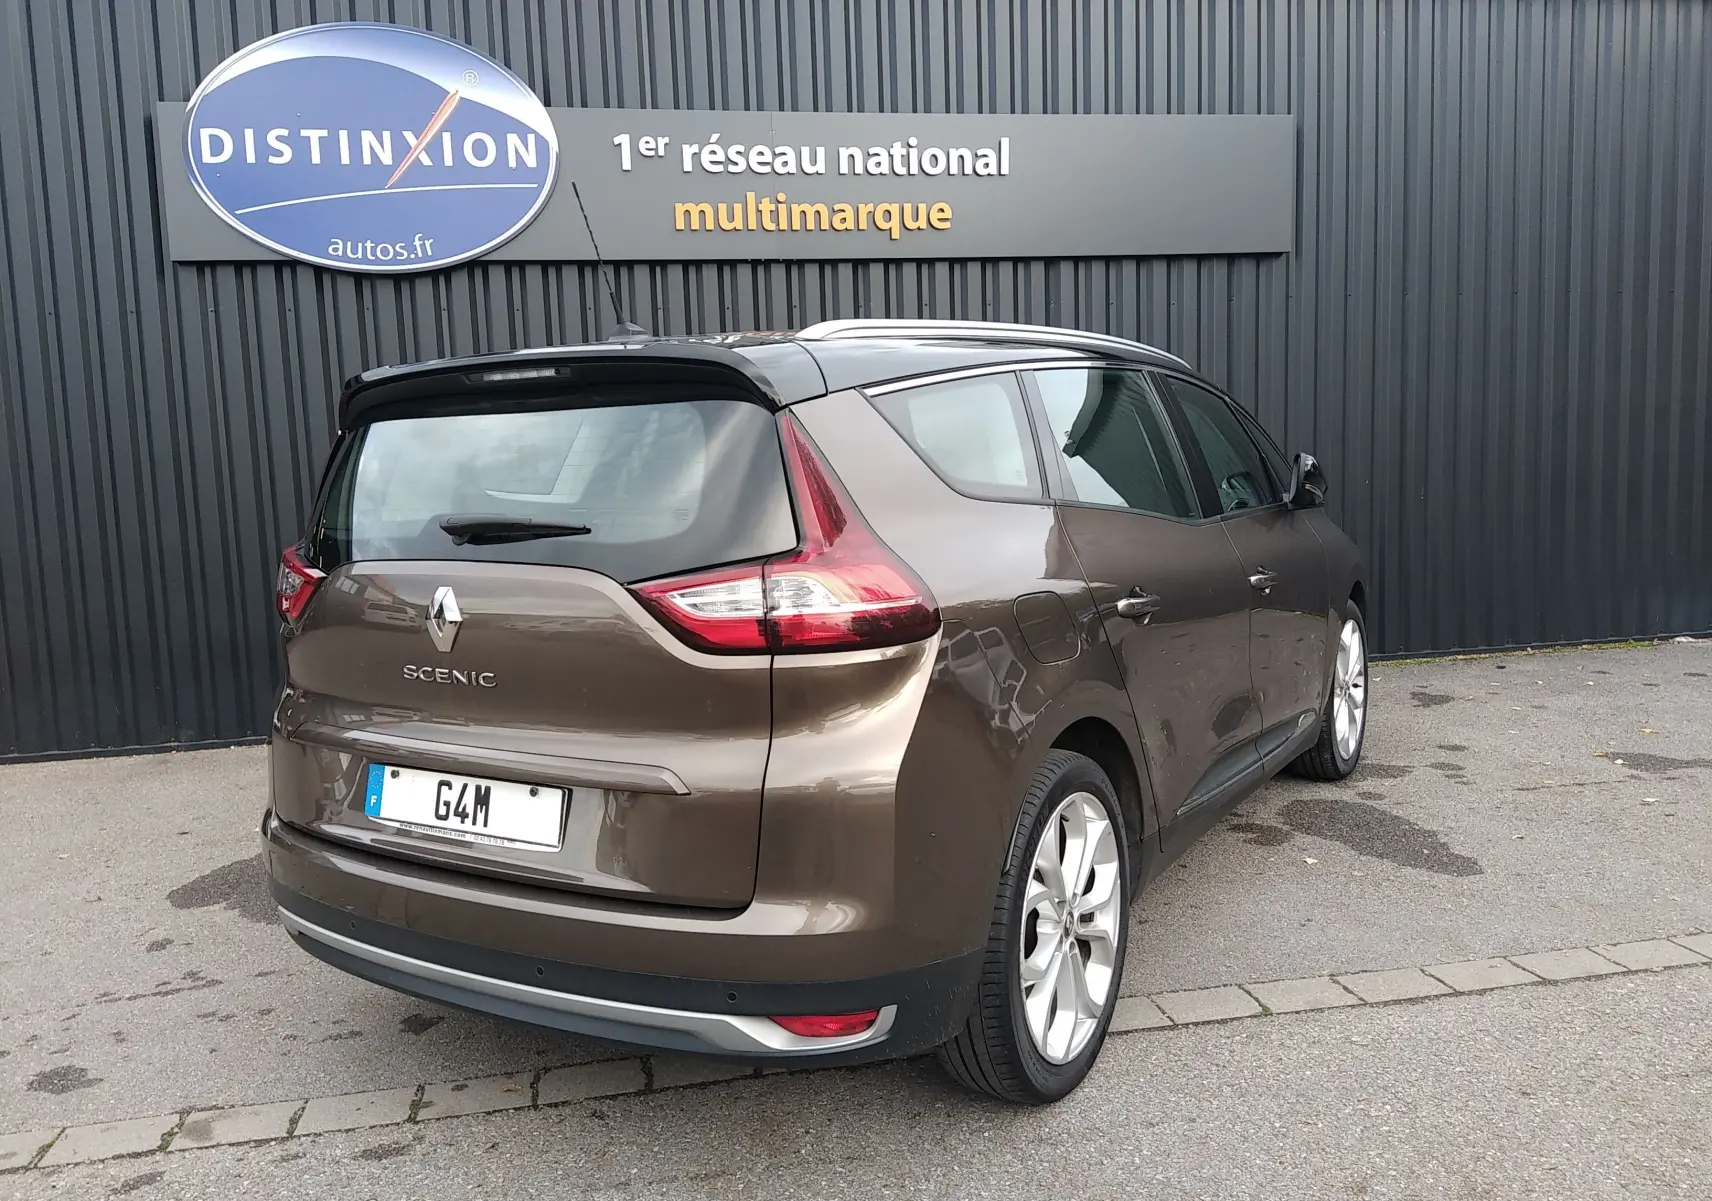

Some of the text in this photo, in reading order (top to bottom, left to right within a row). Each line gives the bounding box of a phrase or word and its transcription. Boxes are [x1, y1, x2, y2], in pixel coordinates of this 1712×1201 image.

[200, 127, 538, 169] DISTINXION
[612, 132, 1011, 176] 1er réseau national
[674, 191, 953, 240] multimarque
[328, 233, 433, 261] autos.fr
[403, 665, 498, 688] SCENIC
[370, 795, 378, 807] F
[434, 779, 491, 828] G4M
